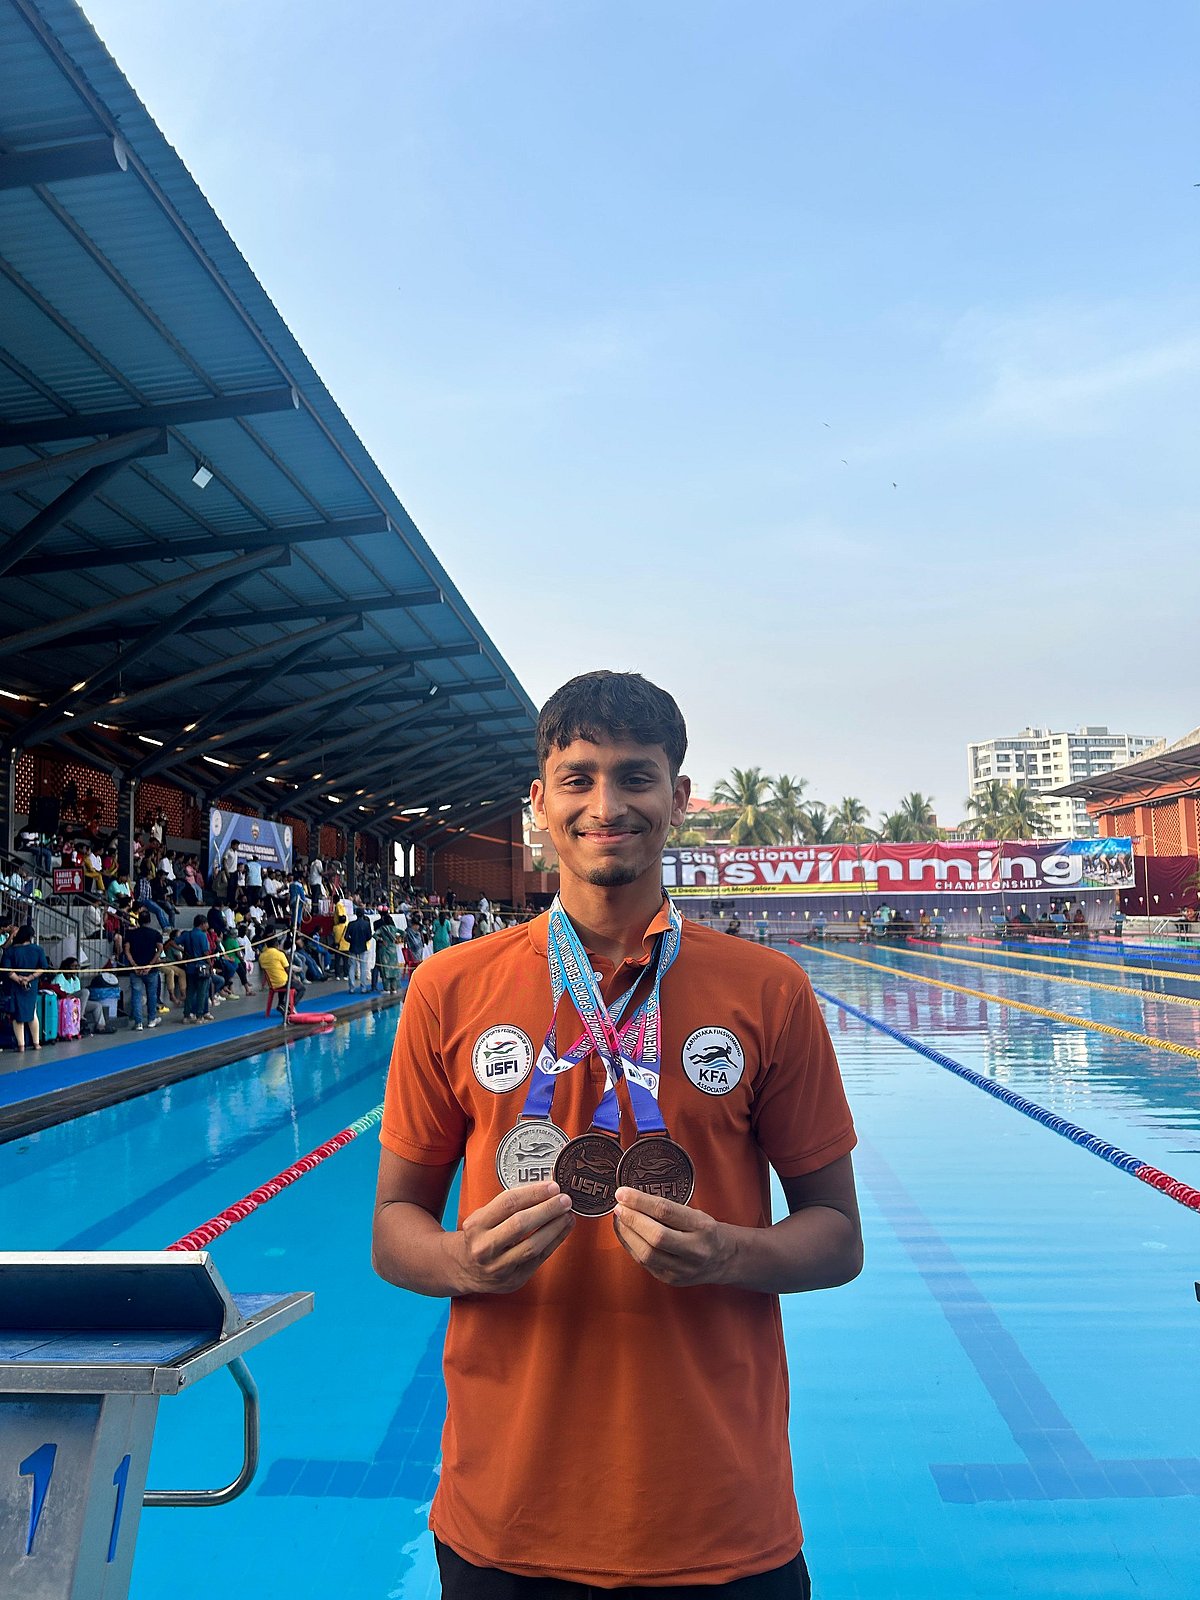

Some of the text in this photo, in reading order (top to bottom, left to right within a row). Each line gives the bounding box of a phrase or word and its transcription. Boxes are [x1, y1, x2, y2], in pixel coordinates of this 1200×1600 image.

[662, 850, 1083, 885] inswimming
[680, 849, 815, 864] 5th National
[935, 879, 1043, 890] CHAMPIONSHIP
[559, 941, 583, 984] FEDERATION
[571, 982, 594, 1009] SPORTS
[642, 1008, 657, 1062] UNDERWATER
[686, 1029, 713, 1051] KARNATAKA
[486, 1060, 518, 1077] USFI
[699, 1068, 728, 1084] KFA
[697, 1081, 730, 1093] ASSOCIATION
[571, 1175, 610, 1199] USFI
[19, 1443, 57, 1556] 1
[108, 1454, 131, 1563] 1
